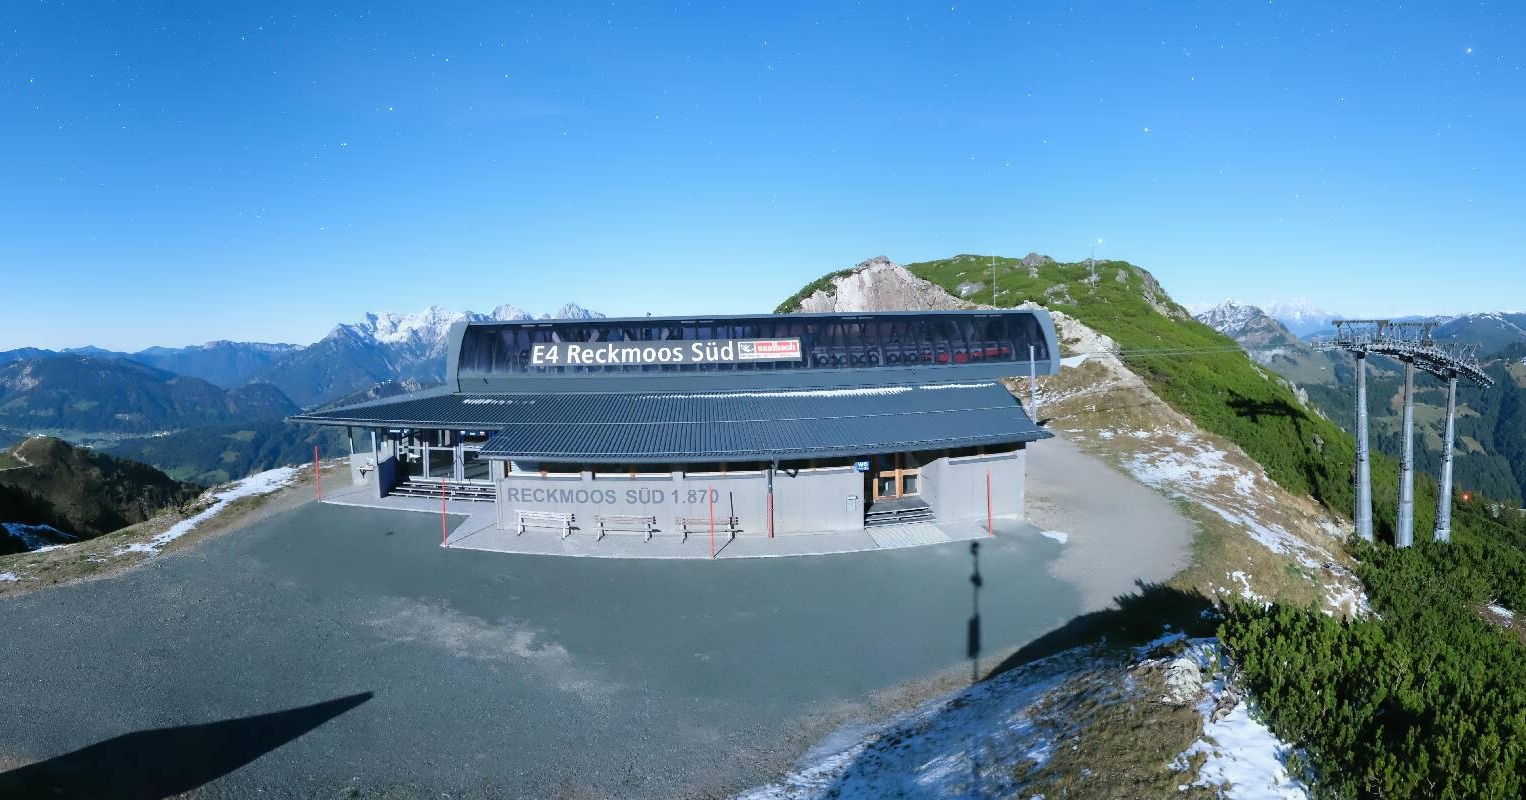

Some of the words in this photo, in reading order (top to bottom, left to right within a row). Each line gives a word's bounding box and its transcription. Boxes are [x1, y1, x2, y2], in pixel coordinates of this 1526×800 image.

[532, 345, 559, 364] E4
[567, 343, 684, 364] Reckmoos
[691, 341, 734, 362] Süd
[507, 487, 617, 504] RECKMOOS
[625, 487, 665, 505] SÜD
[671, 489, 719, 504] 1.870
